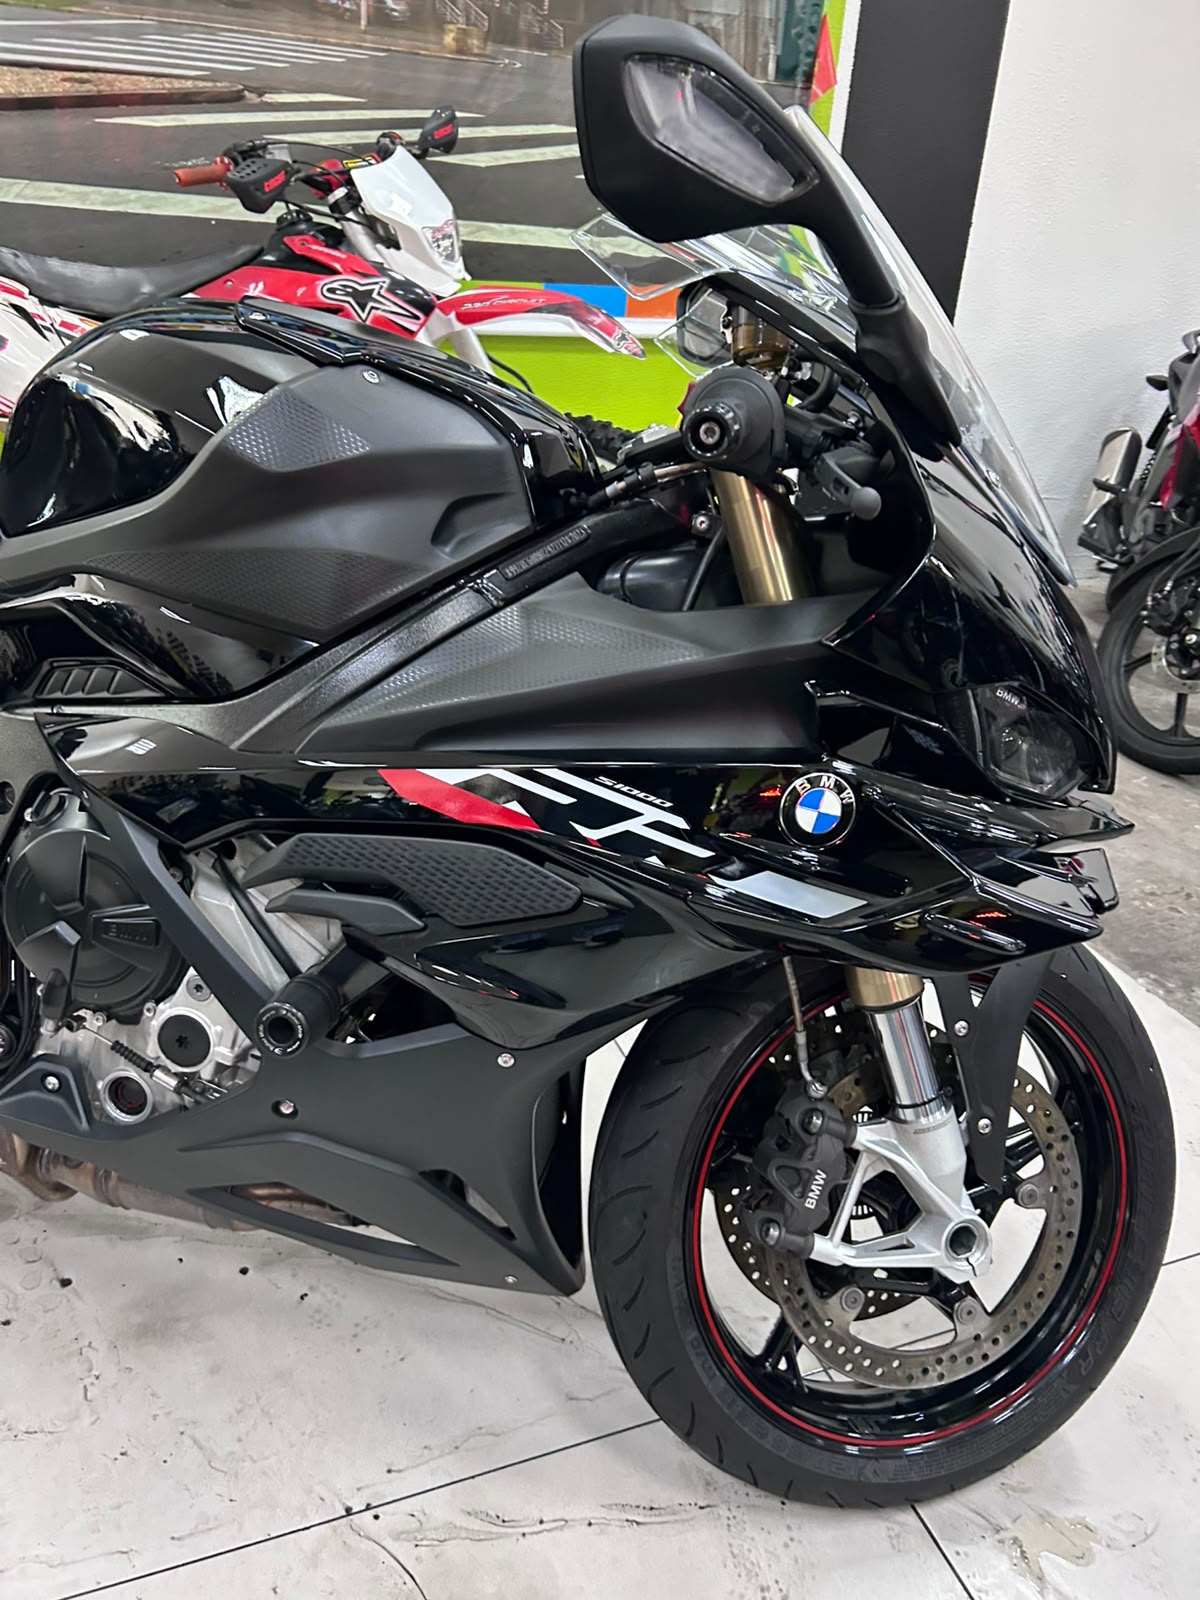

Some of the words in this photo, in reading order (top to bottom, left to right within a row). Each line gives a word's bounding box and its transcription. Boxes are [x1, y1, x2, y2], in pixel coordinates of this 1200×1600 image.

[994, 687, 1021, 706] BMW
[594, 775, 675, 809] S1000
[794, 774, 855, 806] BMW
[804, 1168, 828, 1211] BMW
